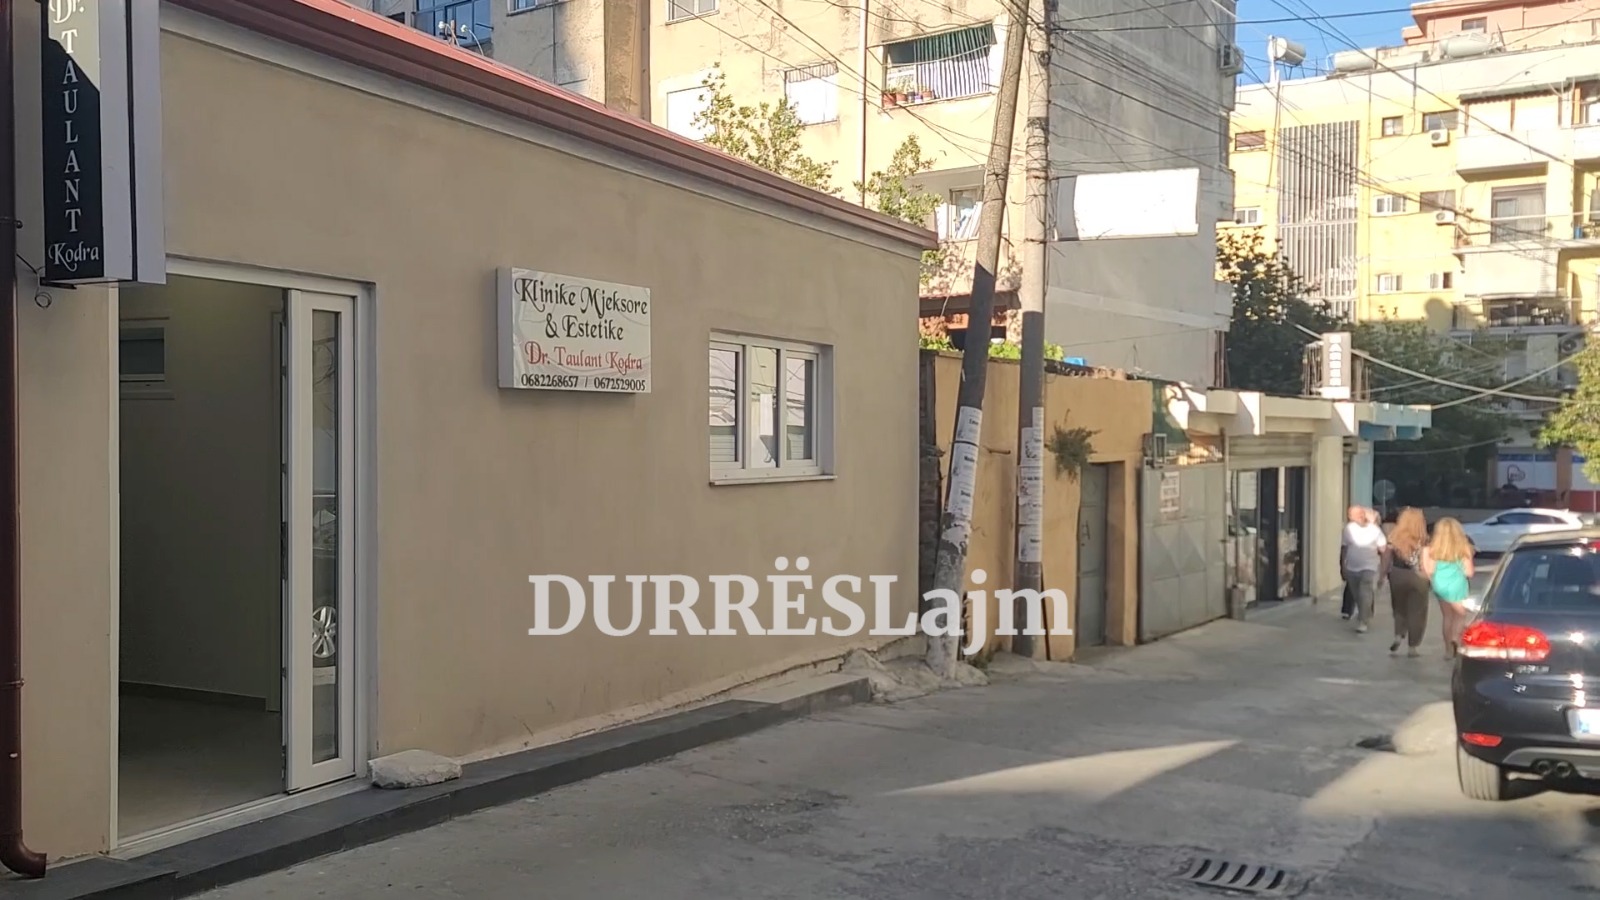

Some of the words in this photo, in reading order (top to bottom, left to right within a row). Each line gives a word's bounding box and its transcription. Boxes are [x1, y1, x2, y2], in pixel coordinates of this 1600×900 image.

[61, 29, 82, 233] TAULANT
[48, 241, 100, 272] Kodra
[514, 278, 576, 312] Klinike
[580, 286, 648, 319] Mjeksore
[545, 313, 560, 339] &
[562, 314, 624, 341] Estetike
[524, 341, 551, 365] Dr.
[554, 346, 602, 368] Taulant
[605, 351, 643, 376] Kodra
[520, 373, 579, 388] 0682268657
[584, 376, 589, 388] /
[593, 376, 646, 391] 0672529005
